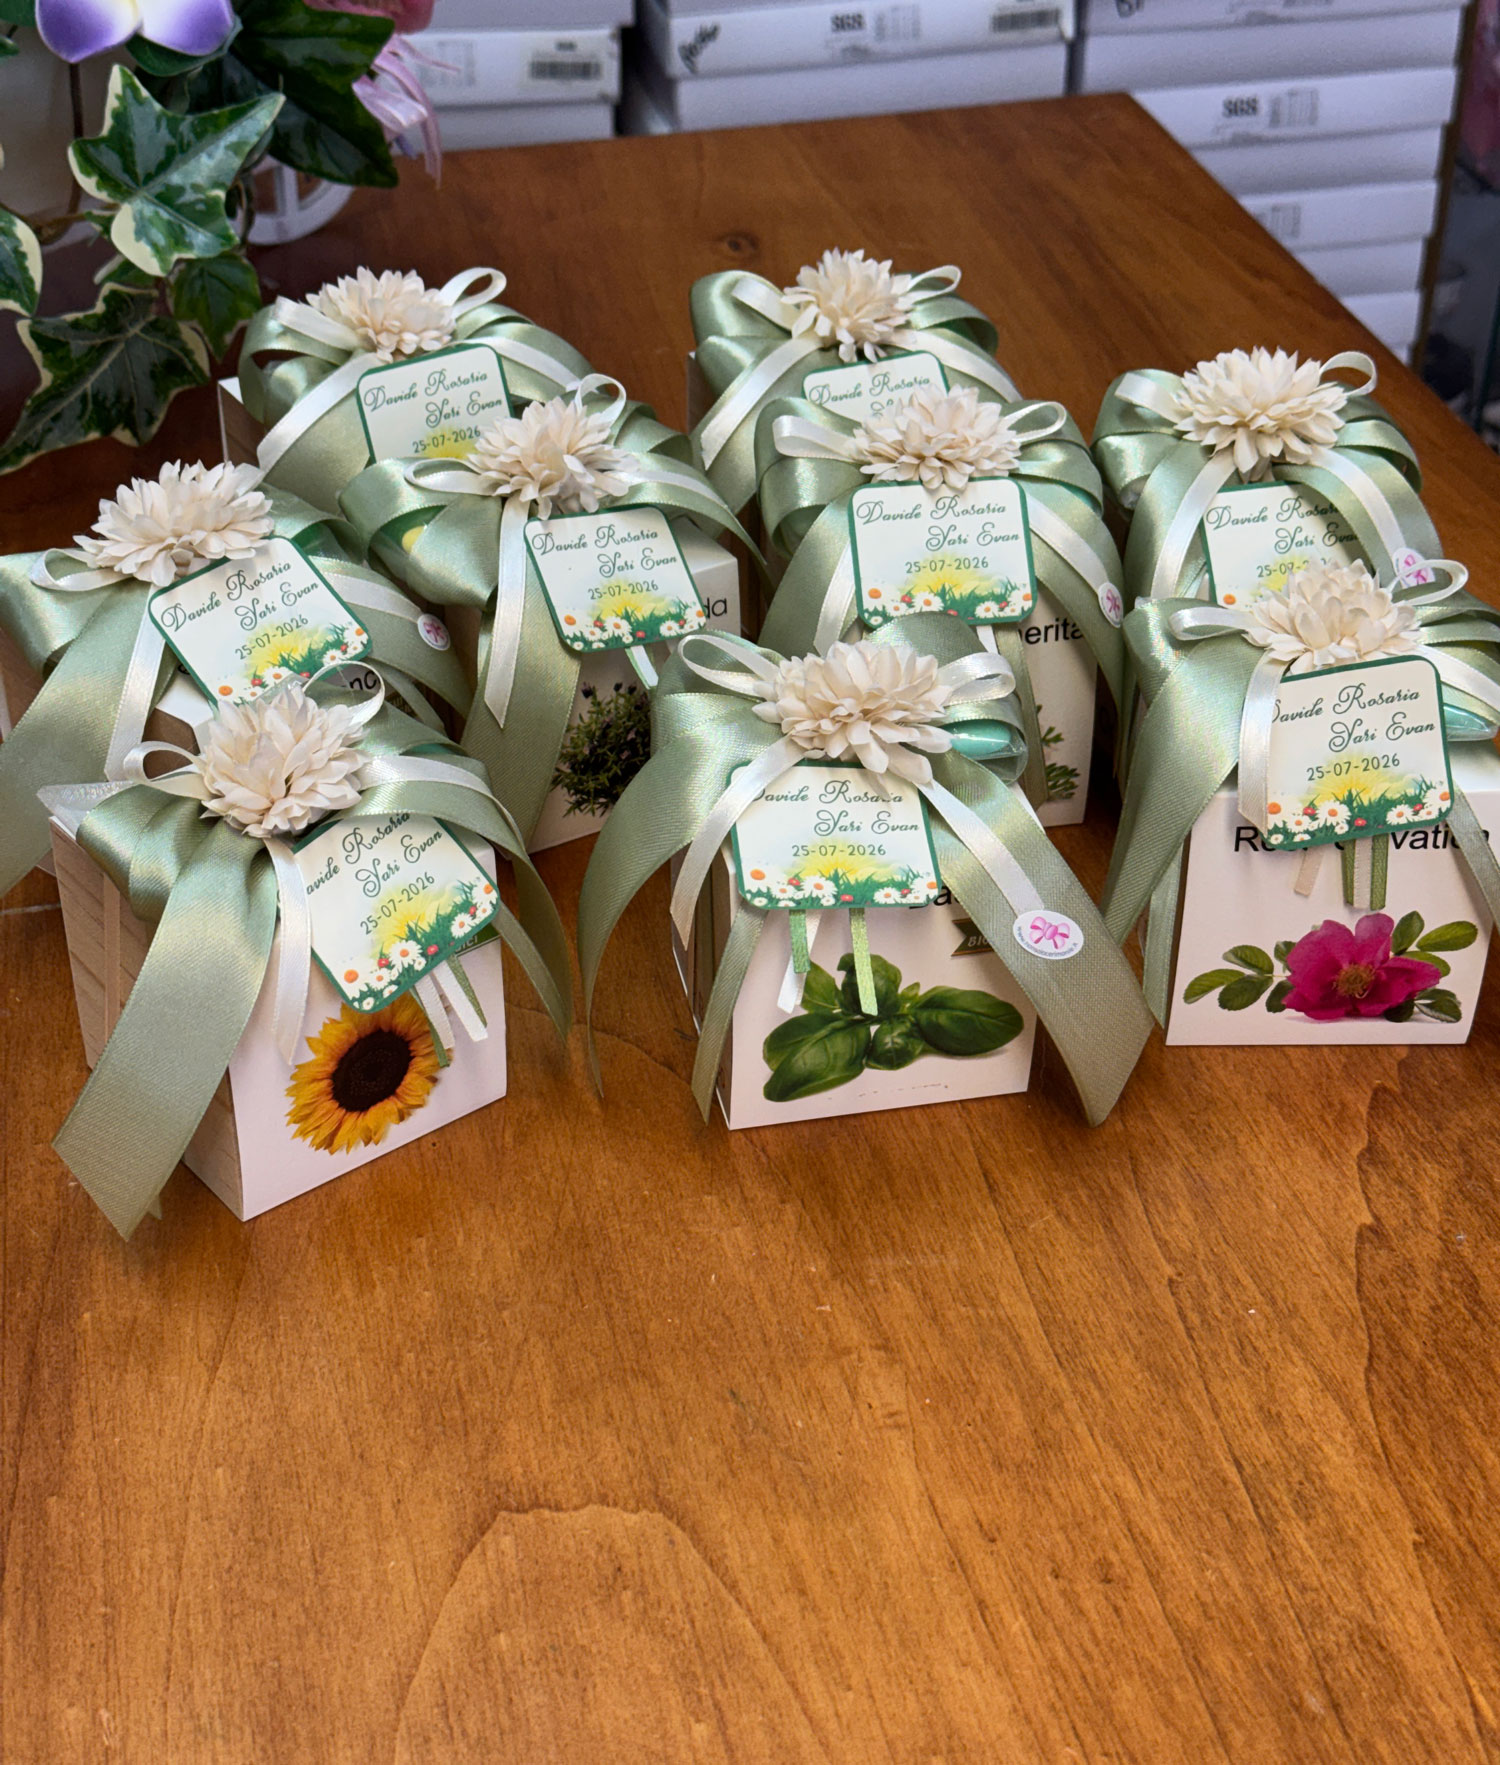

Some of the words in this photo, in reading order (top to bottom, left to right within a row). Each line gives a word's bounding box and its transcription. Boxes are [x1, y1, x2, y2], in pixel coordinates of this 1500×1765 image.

[364, 383, 418, 412] Davide
[467, 391, 502, 416] Evan
[809, 383, 863, 406] Davide
[412, 425, 481, 453] 25-07-2026
[856, 500, 922, 526] Davide
[930, 495, 1007, 520] Rosaria
[1206, 505, 1269, 530] Davide
[1276, 495, 1339, 524] Rosar
[532, 532, 588, 556] Davide
[594, 524, 658, 549] Rosaria
[925, 524, 969, 552] Yari
[976, 522, 1020, 546] Evan
[1322, 522, 1359, 547] Eva
[597, 551, 635, 578] Yari
[640, 547, 677, 571] Evan
[905, 557, 989, 574] 25-07-2026
[160, 591, 222, 632] Davide
[225, 562, 292, 601] Rosaria
[587, 580, 659, 600] 25-07-2026
[234, 598, 277, 631] Yari
[279, 581, 319, 607] Evan
[235, 615, 309, 660] 25-07-2026
[1333, 683, 1420, 715] Rosaria
[1329, 718, 1377, 753] Yari
[1385, 712, 1435, 741] Evan
[1306, 753, 1400, 781] 25-07-2026
[752, 785, 809, 802] avide
[813, 809, 863, 836] Yari
[871, 810, 919, 834] Evan
[306, 856, 340, 895] avide
[342, 813, 410, 864] Rosaria
[355, 858, 400, 897] Yari
[400, 834, 443, 863] Evan
[791, 844, 886, 857] 25-07-2026
[360, 872, 435, 935] 25-07-2026
